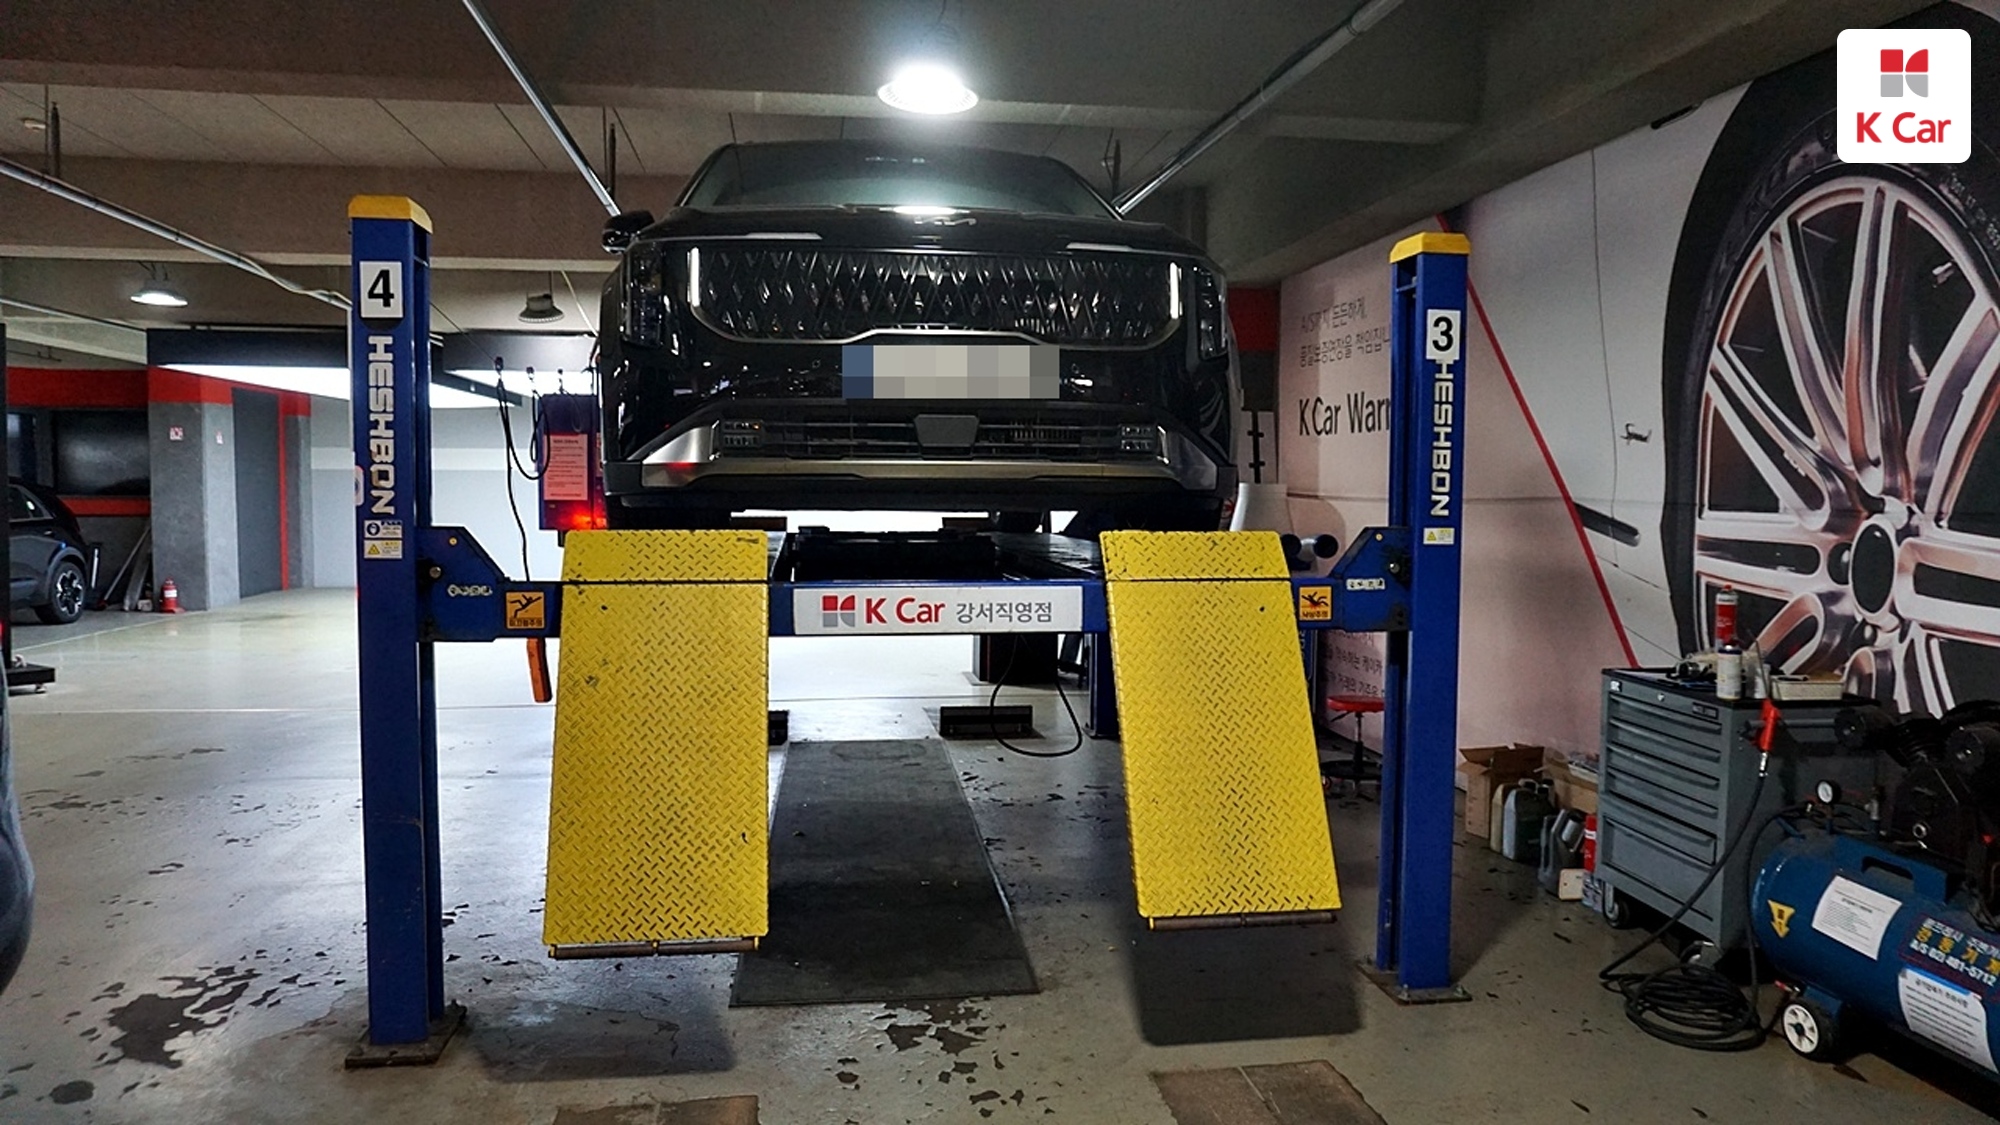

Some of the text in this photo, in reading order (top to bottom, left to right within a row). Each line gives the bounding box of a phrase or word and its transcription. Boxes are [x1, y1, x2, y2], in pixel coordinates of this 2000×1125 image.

[367, 269, 395, 308] 4
[1432, 316, 1454, 352] 3
[367, 335, 396, 515] HESHBON
[1430, 359, 1455, 517] HESHBON
[865, 597, 1053, 625] K Car 강서직영점
